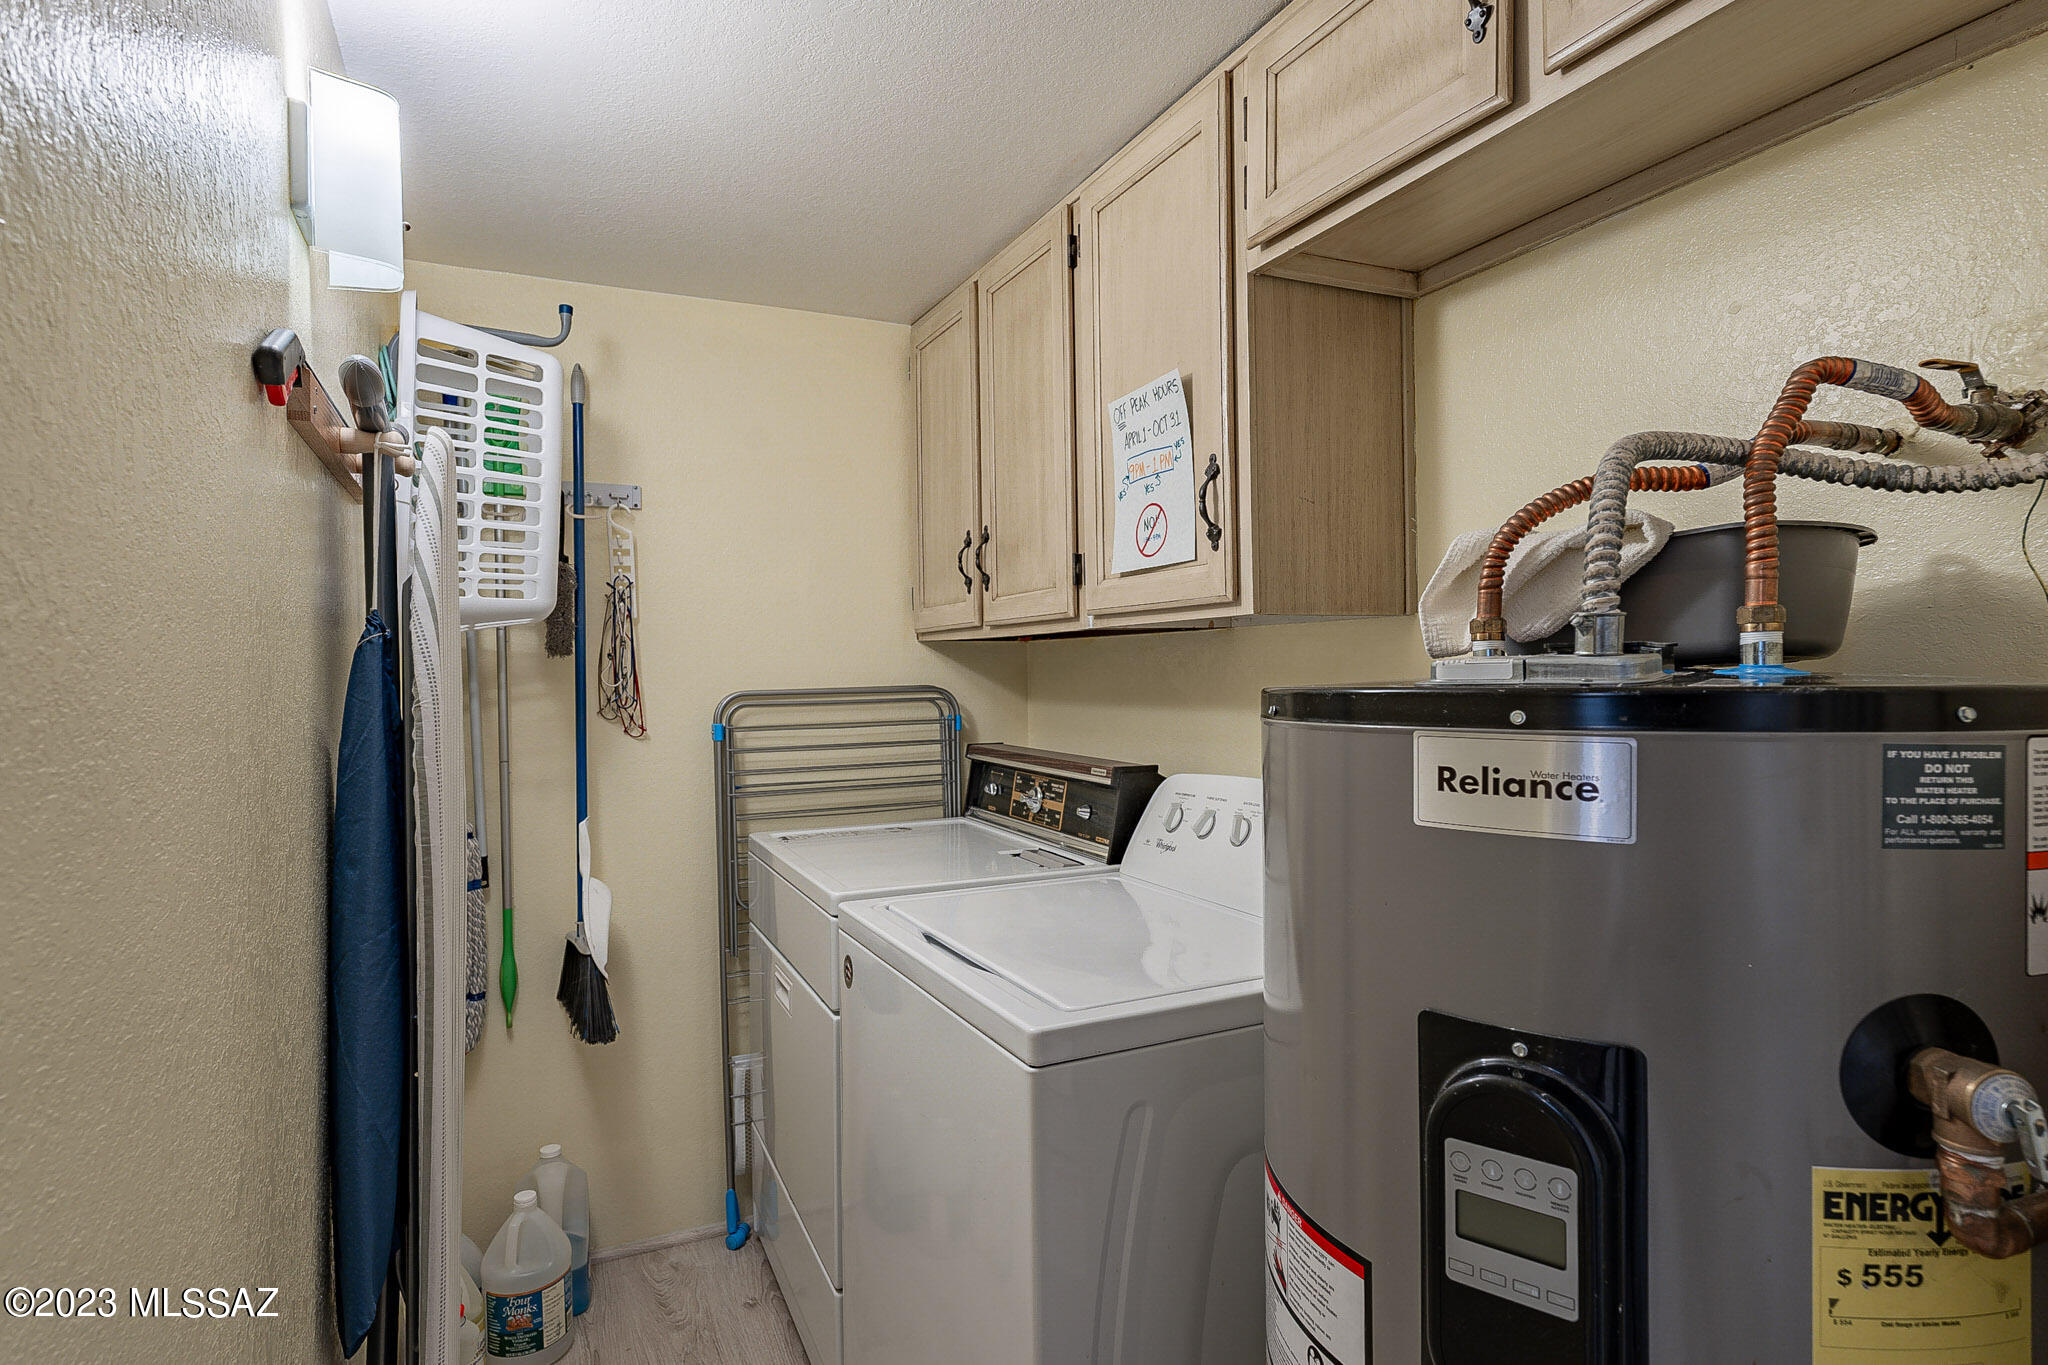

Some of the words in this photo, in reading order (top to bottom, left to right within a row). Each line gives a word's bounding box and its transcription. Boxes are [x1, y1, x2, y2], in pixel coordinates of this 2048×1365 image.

[1113, 404, 1126, 424] OFF
[1129, 394, 1150, 417] PEAK
[1152, 378, 1180, 401] HOURS
[1174, 436, 1185, 450] YES
[1144, 483, 1155, 495] YES
[1887, 750, 1898, 758] IF
[1900, 750, 1921, 758] YOU
[1922, 751, 1950, 759] HAVE
[1951, 751, 1959, 759] A
[1960, 751, 2002, 759] PROBLEM
[1924, 764, 1942, 773] DO
[1945, 764, 1971, 773] NOT
[1530, 770, 1559, 780] Water
[1562, 772, 1600, 782] Heaters
[1919, 776, 1954, 784] RETURN
[1955, 776, 1975, 784] THIS
[1437, 766, 1600, 802] Reliance
[1899, 797, 1918, 805] THE
[1919, 797, 1946, 805] PLACE
[1947, 797, 1959, 805] OF
[1896, 814, 1918, 824] Call
[1868, 1248, 1912, 1257] Estimated
[1913, 1248, 1940, 1257] Yearly
[1941, 1247, 1969, 1256] Energy
[1837, 1268, 1853, 1288] $
[1862, 1264, 1924, 1288] 555
[507, 1296, 532, 1306] Four
[502, 1303, 537, 1317] Monks
